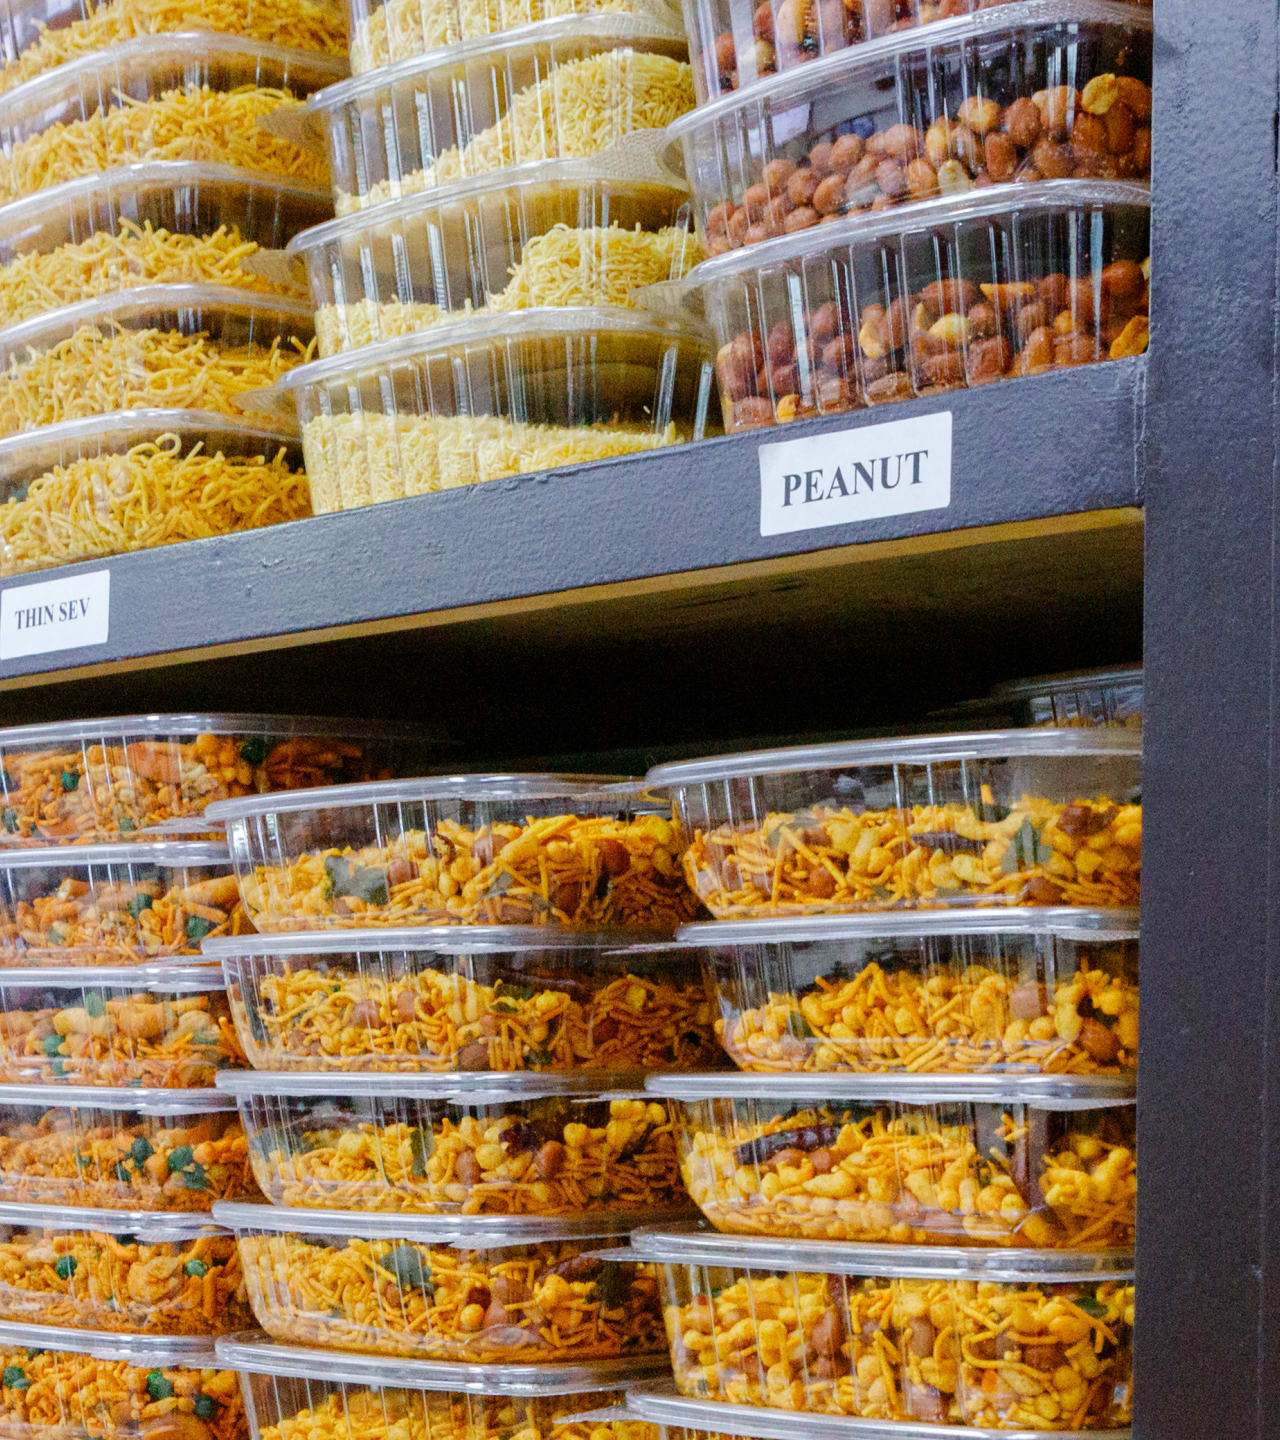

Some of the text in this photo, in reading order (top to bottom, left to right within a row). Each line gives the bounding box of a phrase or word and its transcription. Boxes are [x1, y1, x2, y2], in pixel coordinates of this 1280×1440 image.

[781, 449, 929, 507] PEANUT
[14, 597, 91, 630] THIN SEV
